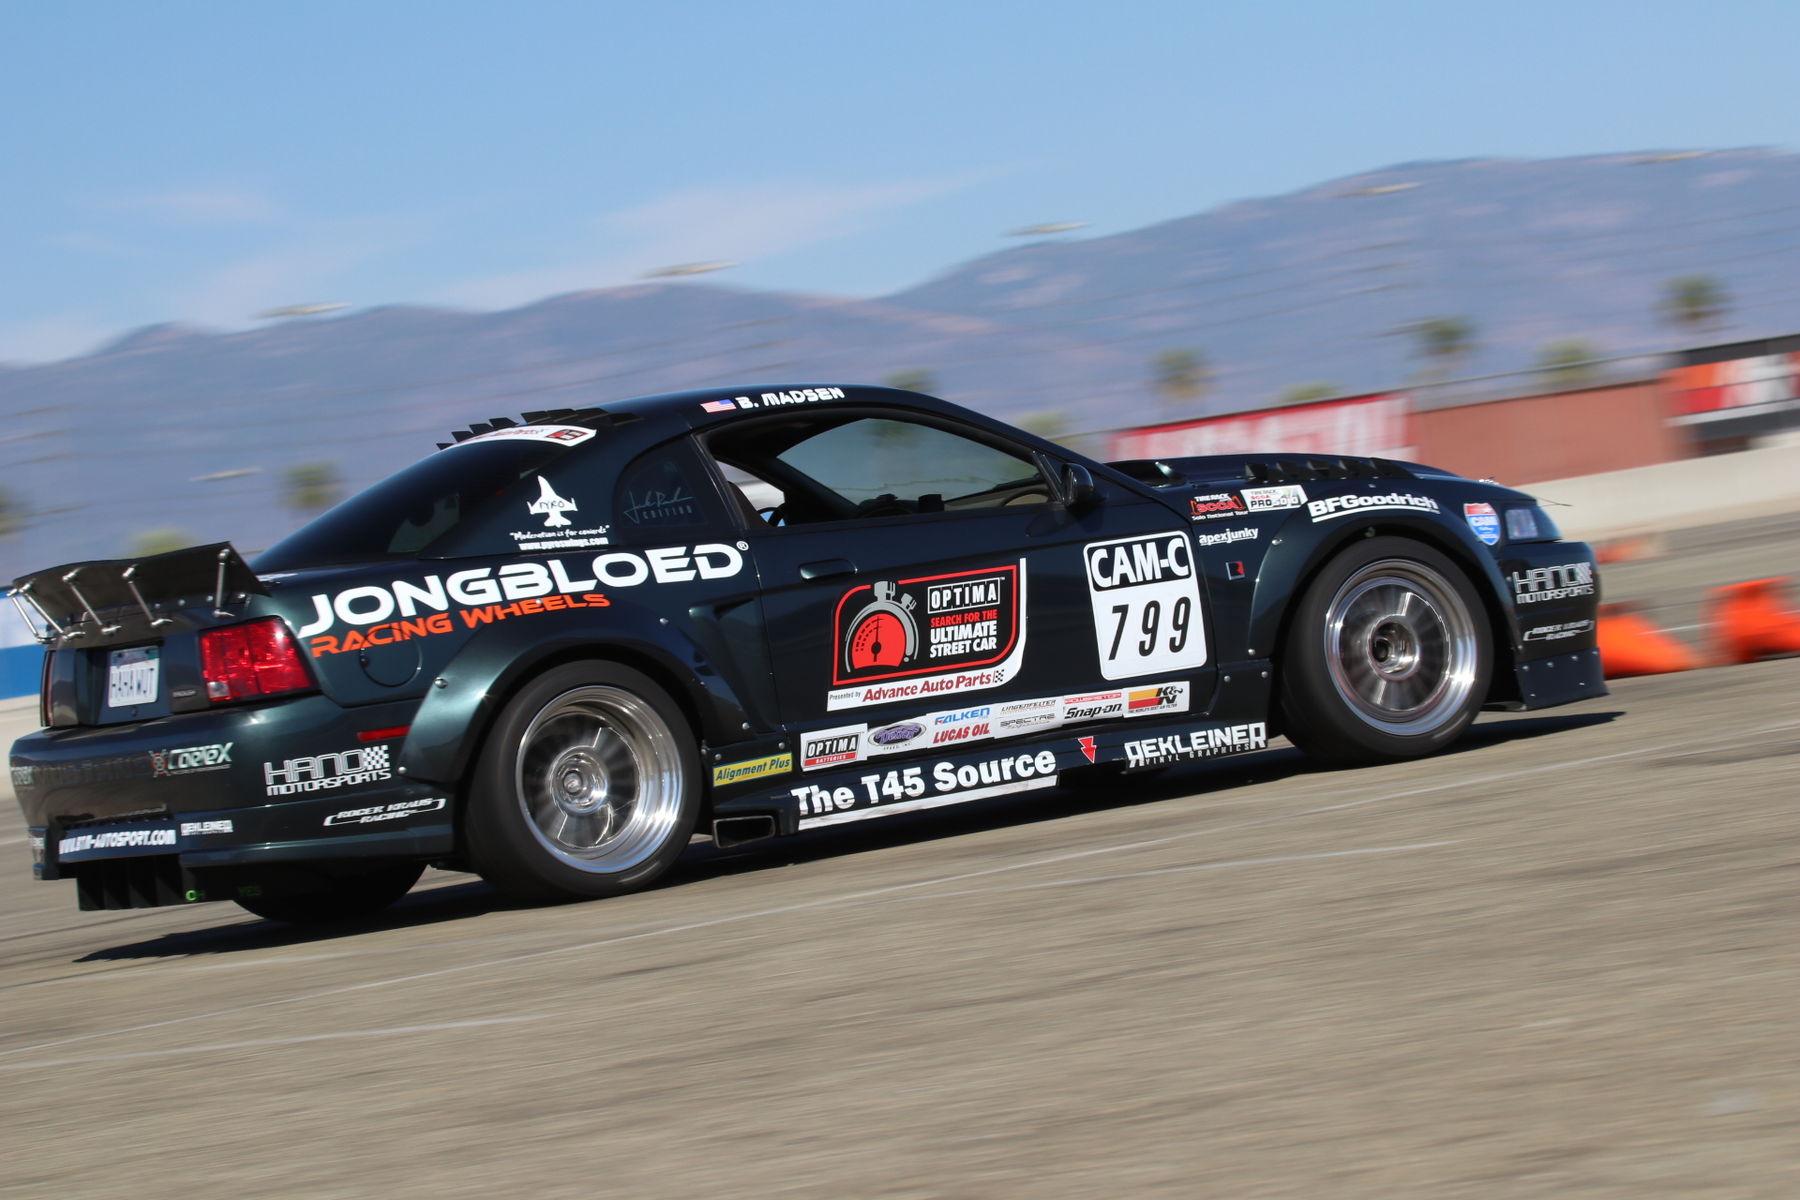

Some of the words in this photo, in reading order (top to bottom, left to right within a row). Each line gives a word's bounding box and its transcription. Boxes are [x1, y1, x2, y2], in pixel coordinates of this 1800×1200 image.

[735, 396, 759, 409] B.
[761, 387, 845, 406] MADSEN
[1196, 500, 1238, 513] SCCA
[1307, 493, 1439, 517] BFGoodrich
[1199, 528, 1259, 545] apexjunky
[1090, 537, 1190, 588] CAM-C
[931, 582, 997, 609] OPTIMA
[309, 612, 453, 657] RACING
[463, 593, 611, 628] WHEELS
[930, 615, 962, 628] SEARCH
[963, 611, 980, 623] FOR
[982, 609, 997, 620] THE
[1108, 596, 1192, 661] 799
[930, 620, 997, 644] ULTIMATE
[929, 640, 972, 658] STREET
[973, 636, 997, 652] CAR
[862, 684, 918, 702] Advance
[919, 677, 954, 694] Auto
[955, 671, 991, 689] Parts
[1156, 686, 1183, 705] K&N
[934, 707, 990, 725] FALKEN
[1064, 703, 1122, 720] Snap-on
[933, 726, 971, 744] LUCAS
[972, 722, 990, 737] OIL
[808, 736, 857, 757] OPTIMA
[1146, 755, 1181, 766] VINYL
[1189, 743, 1250, 759] GRAPHICS
[716, 762, 767, 781] Alignment
[769, 756, 790, 770] Plus
[266, 768, 392, 797] MOTORSPORTS
[791, 784, 856, 815] The
[861, 767, 925, 804] T45
[933, 750, 1056, 792] Source
